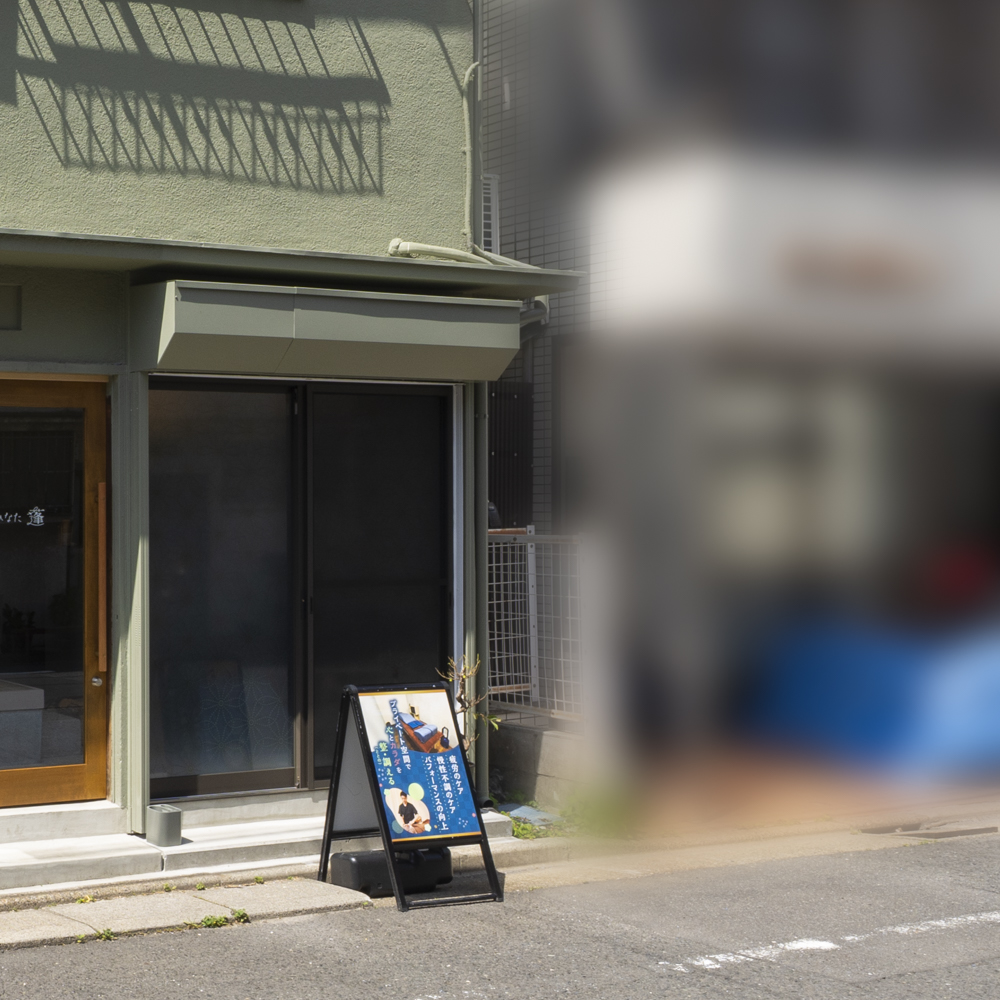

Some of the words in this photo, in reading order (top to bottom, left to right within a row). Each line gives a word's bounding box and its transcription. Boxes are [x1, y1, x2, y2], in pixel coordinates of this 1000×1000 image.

[385, 726, 402, 774] 心とカラダを
[389, 700, 411, 770] プライベート空間で
[425, 756, 449, 831] パフォーマンスの向上
[436, 756, 456, 814] 慢性不調のケア
[449, 755, 464, 795] 疲労のケア
